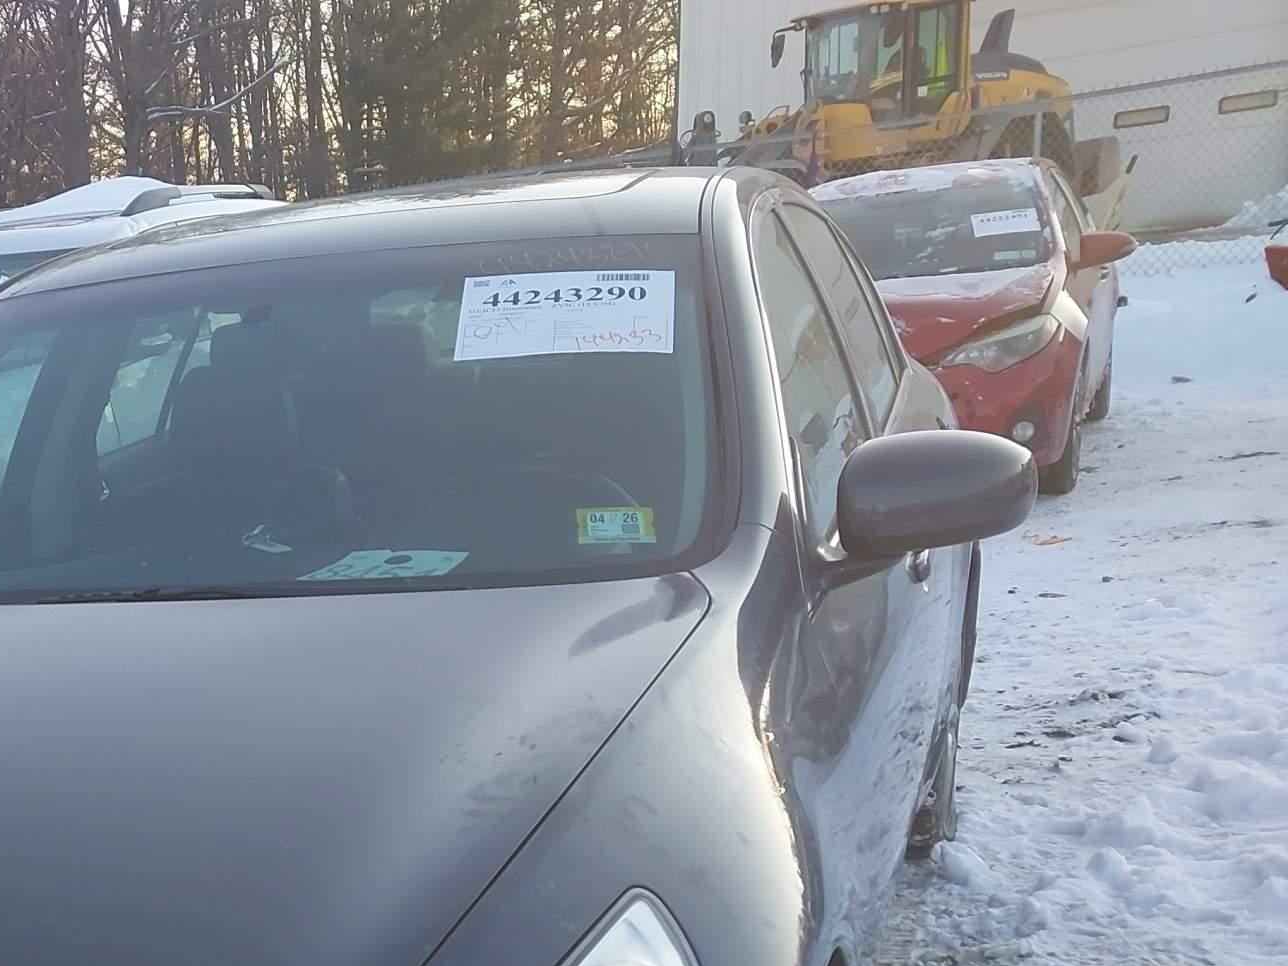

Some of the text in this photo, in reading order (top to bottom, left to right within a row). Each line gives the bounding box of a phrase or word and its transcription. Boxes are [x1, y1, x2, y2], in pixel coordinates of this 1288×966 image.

[482, 285, 648, 307] 44243290
[590, 512, 639, 524] 04 26
